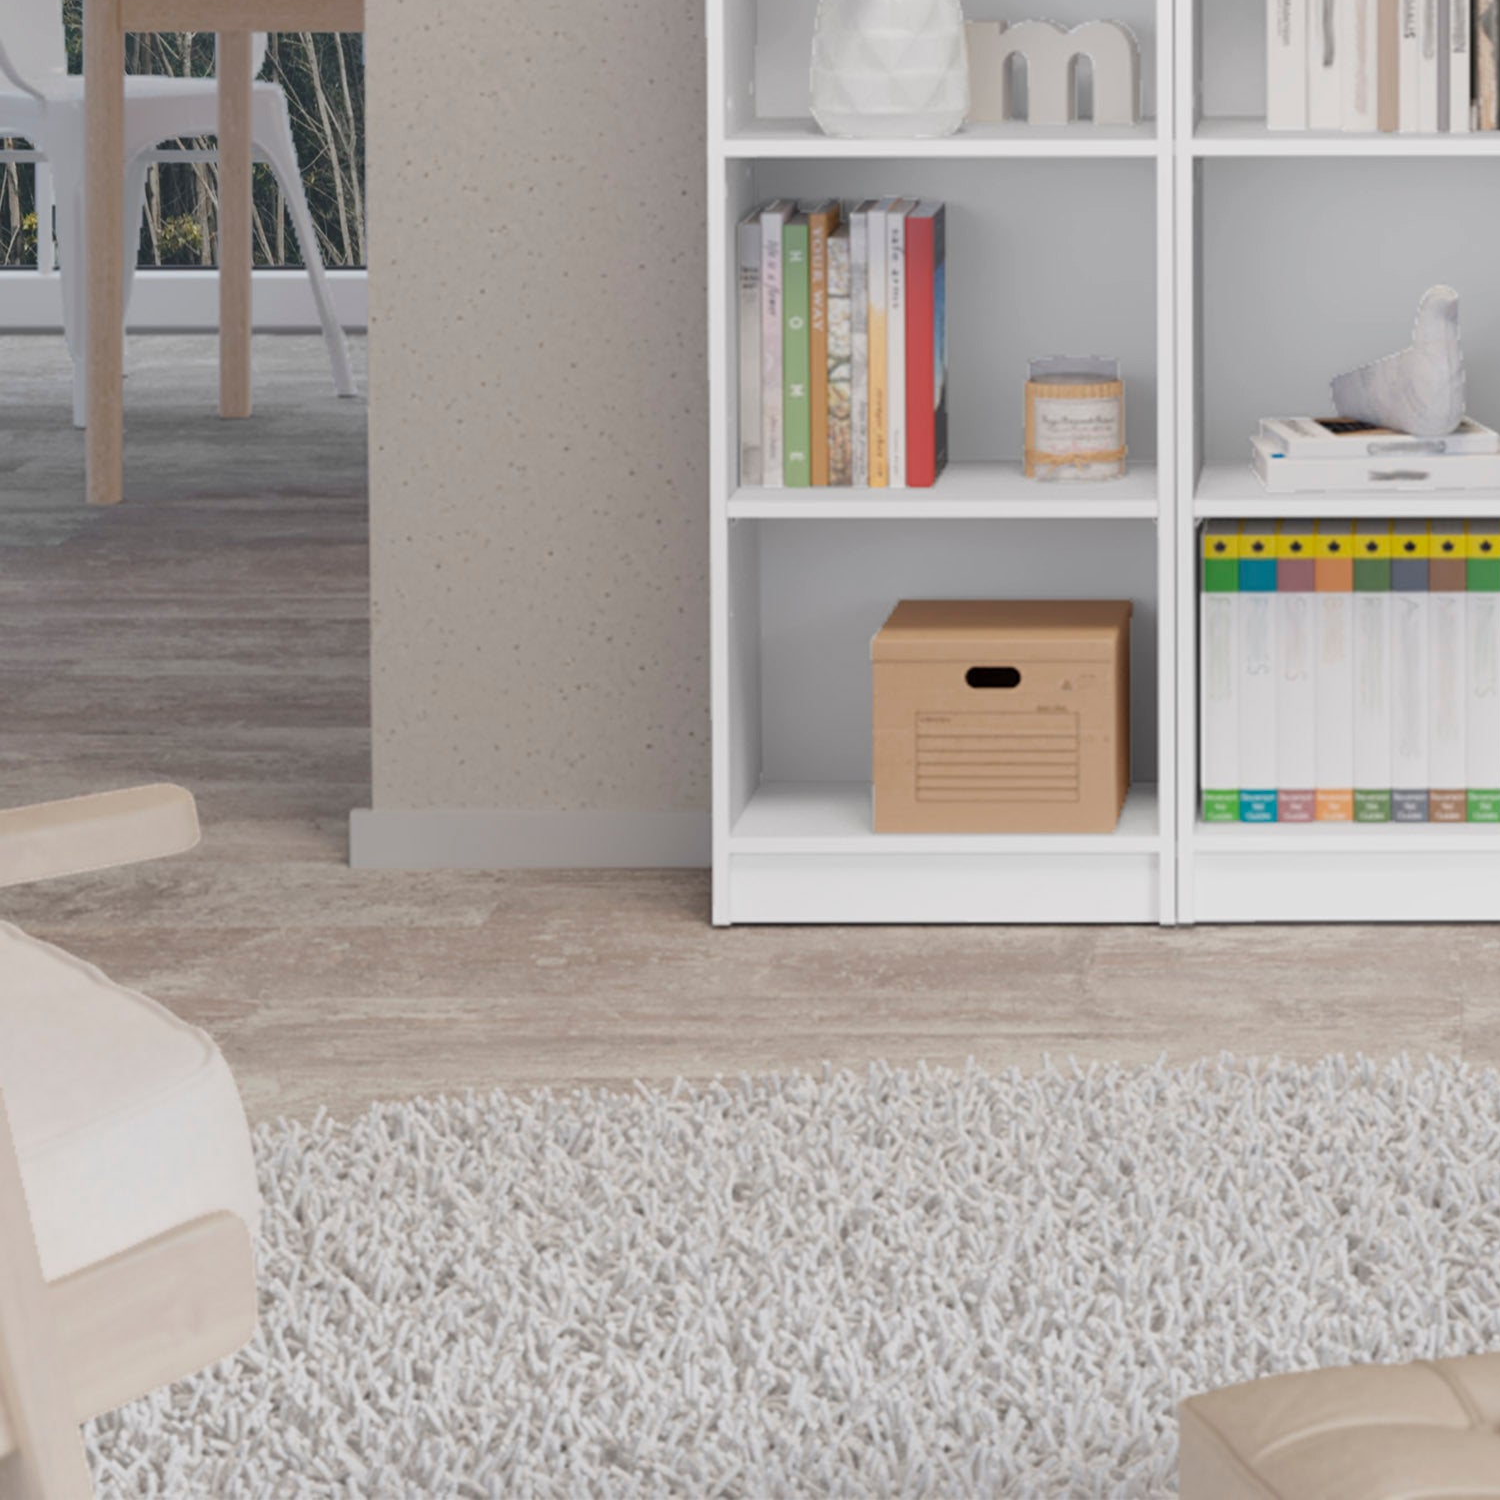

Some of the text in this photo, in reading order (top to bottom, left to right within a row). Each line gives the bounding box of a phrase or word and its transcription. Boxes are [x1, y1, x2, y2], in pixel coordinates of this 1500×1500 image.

[812, 226, 824, 332] YOUR WAY
[891, 228, 904, 260] safe
[788, 250, 804, 461] HOME
